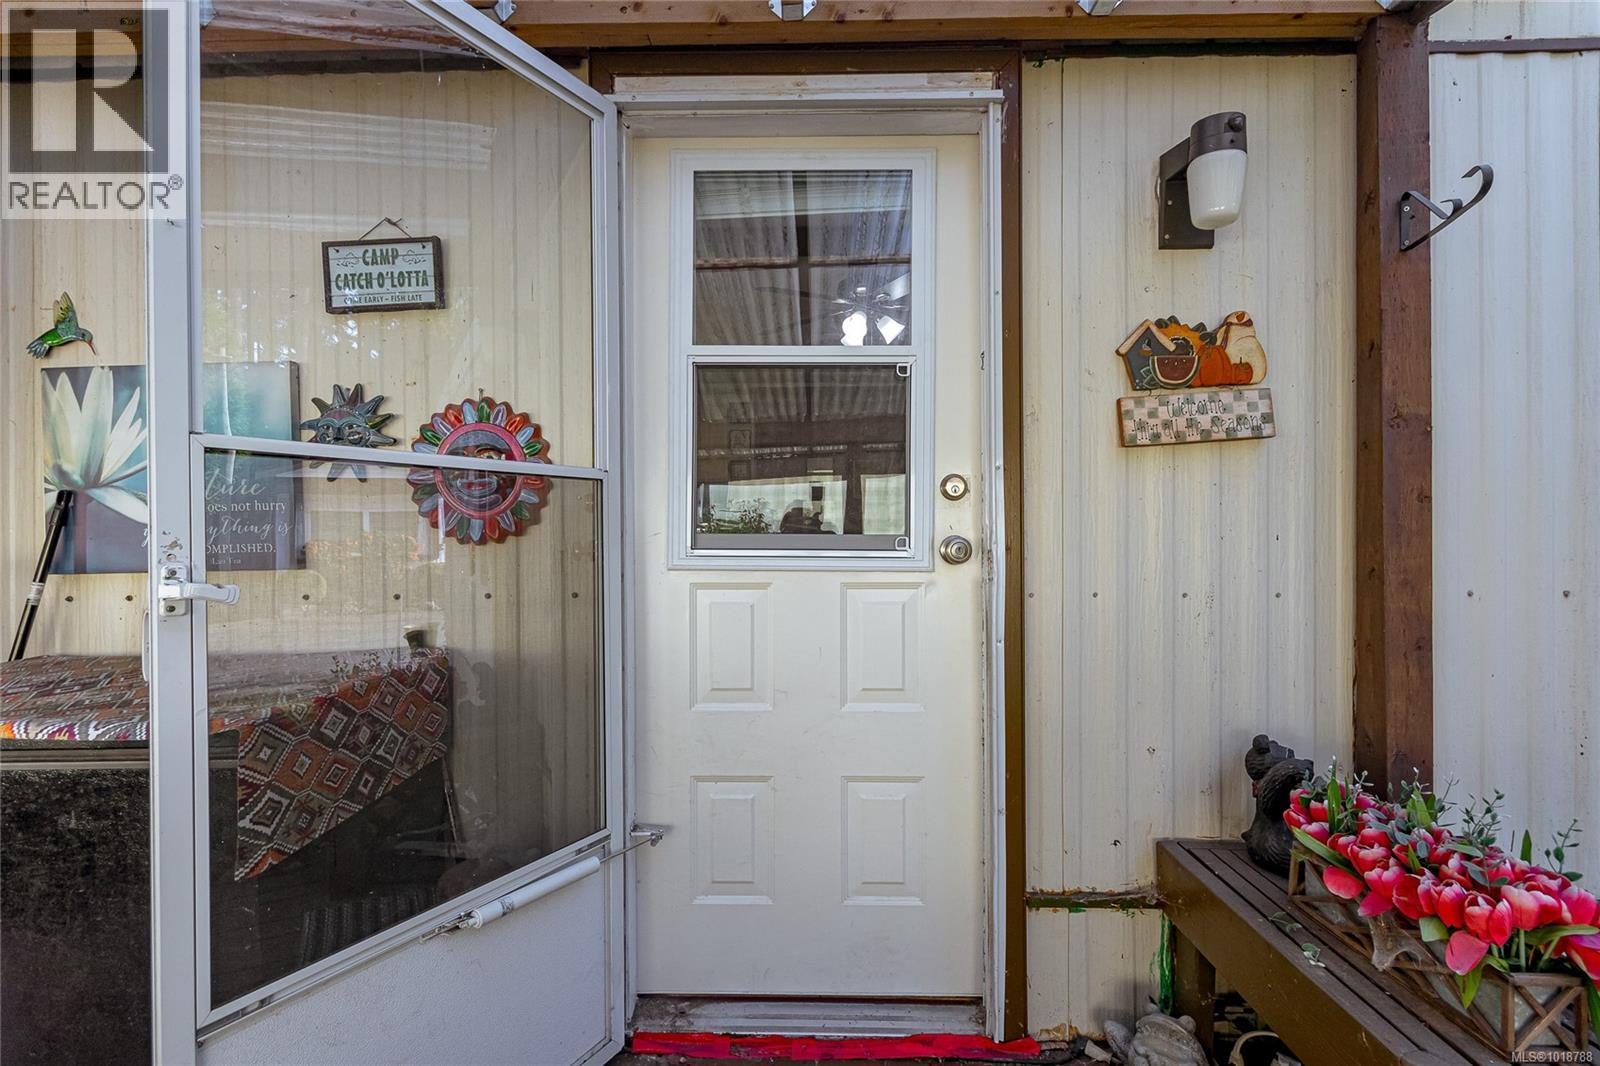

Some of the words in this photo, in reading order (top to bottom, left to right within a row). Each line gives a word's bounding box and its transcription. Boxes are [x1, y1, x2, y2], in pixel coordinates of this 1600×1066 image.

[361, 247, 400, 266] CAMP
[335, 272, 373, 291] CATCH
[1166, 397, 1227, 419] Welcome
[1211, 414, 1266, 434] Seasons
[205, 467, 266, 500] ture
[207, 503, 228, 512] oes
[231, 501, 251, 511] not
[254, 500, 287, 511] hurry
[207, 516, 273, 545] ything
[278, 522, 293, 536] is
